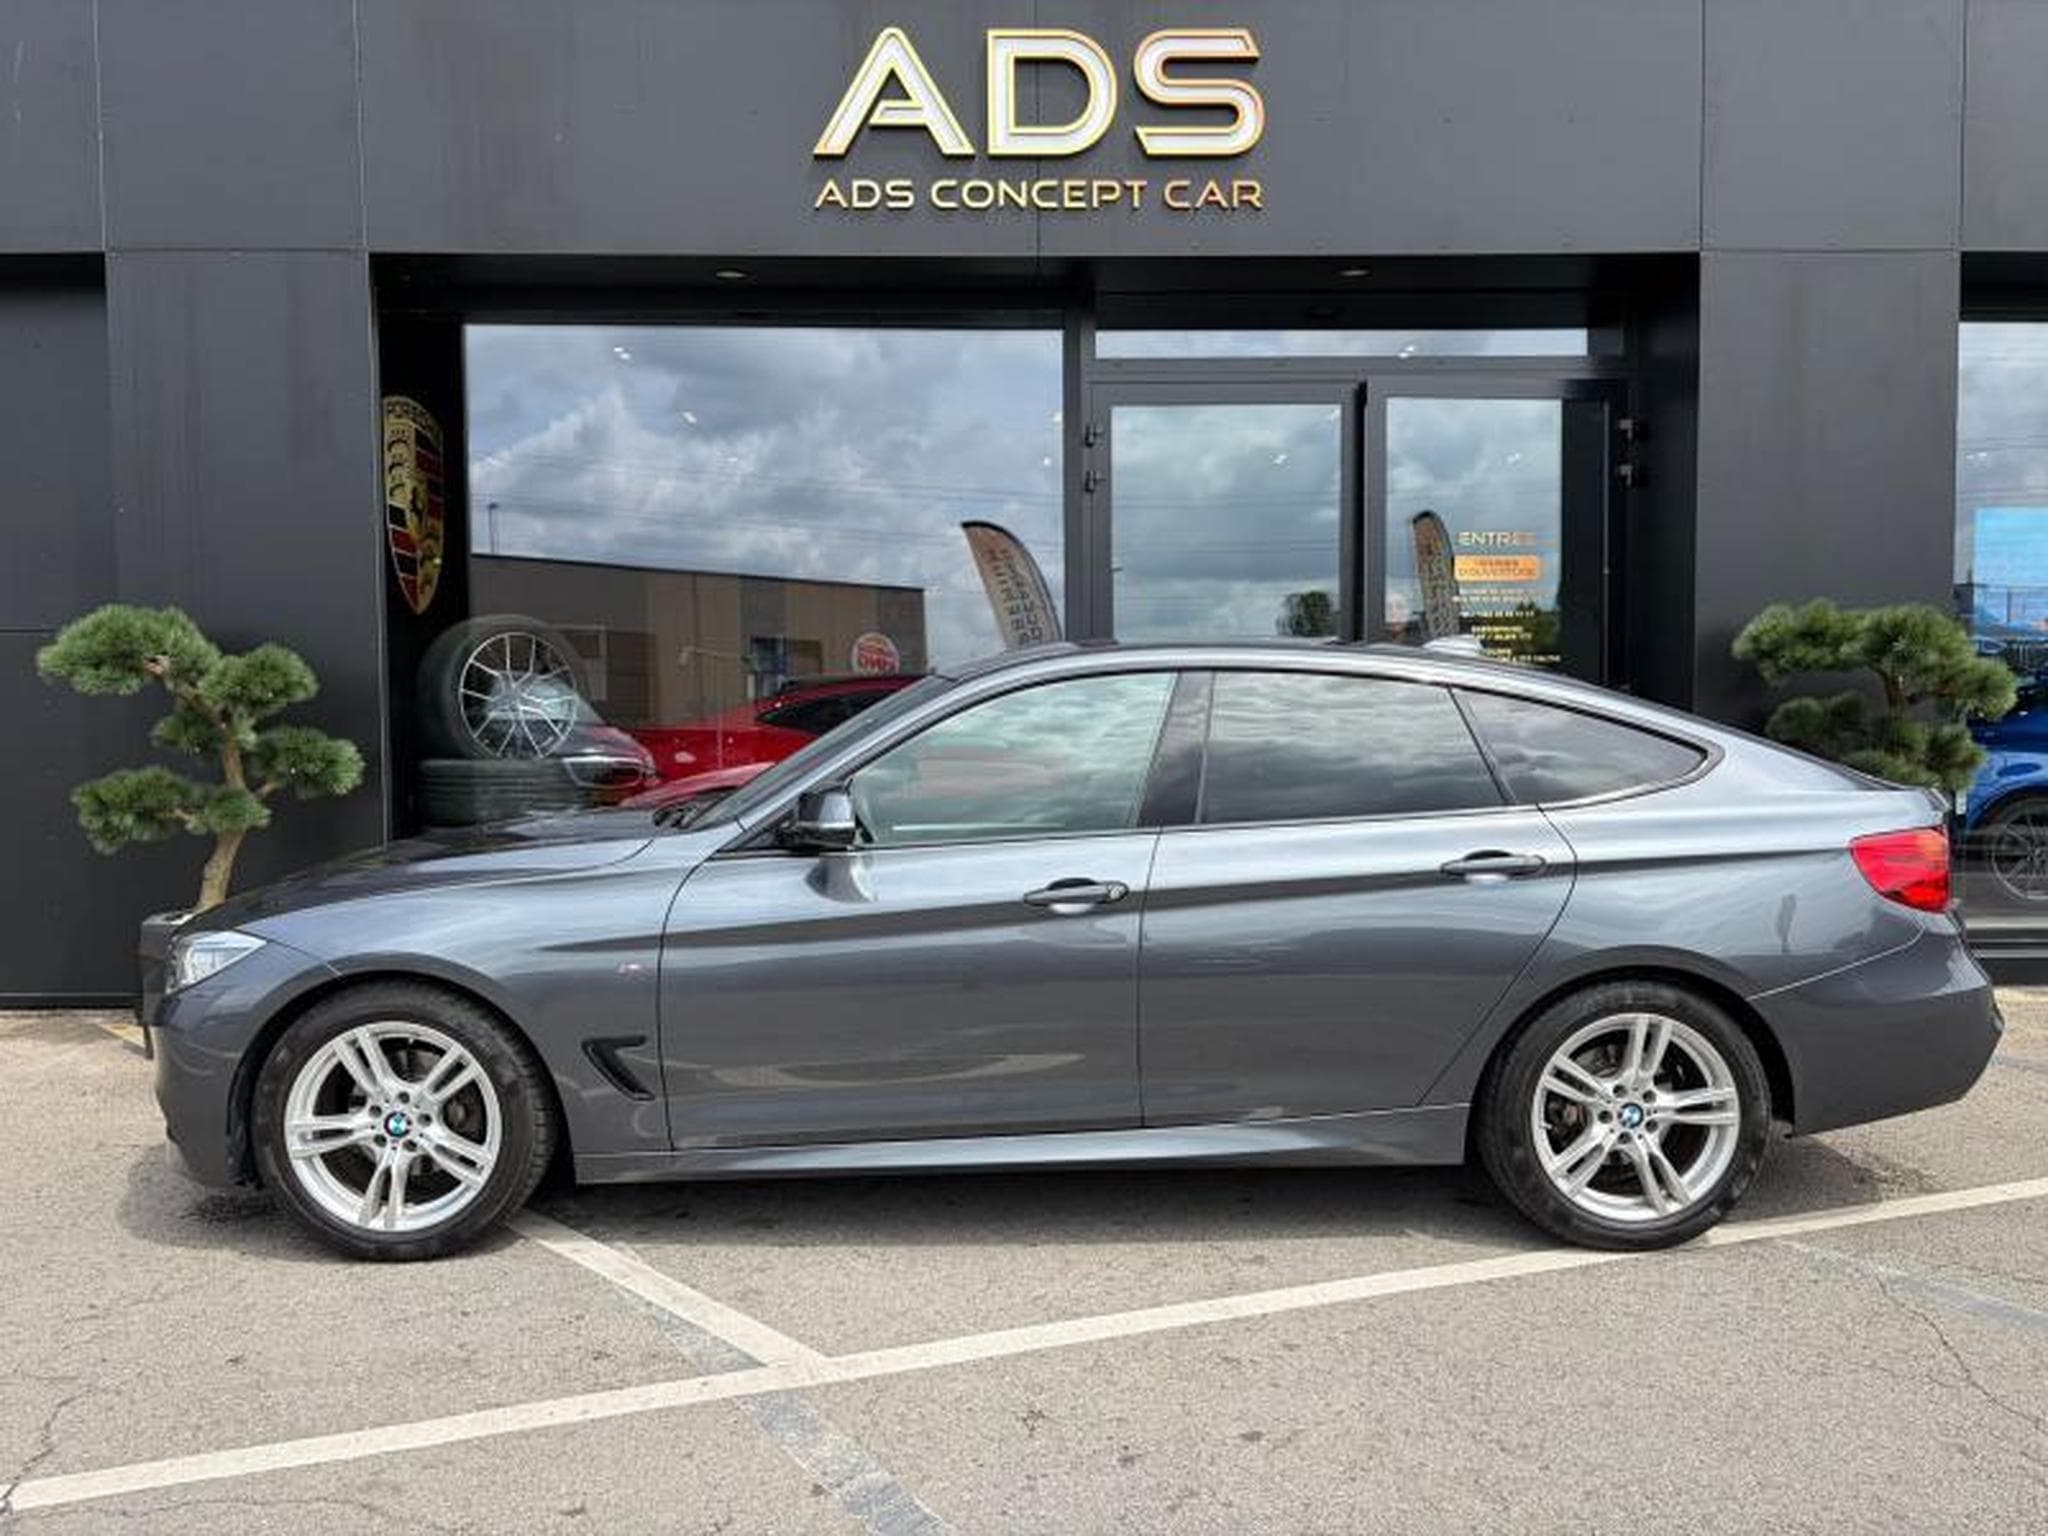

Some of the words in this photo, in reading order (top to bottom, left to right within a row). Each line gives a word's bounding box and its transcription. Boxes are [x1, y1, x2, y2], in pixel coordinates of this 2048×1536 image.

[813, 27, 1266, 156] ADS
[814, 180, 914, 209] ADS
[931, 180, 1148, 209] CONCEPT
[1164, 180, 1264, 209] CAR
